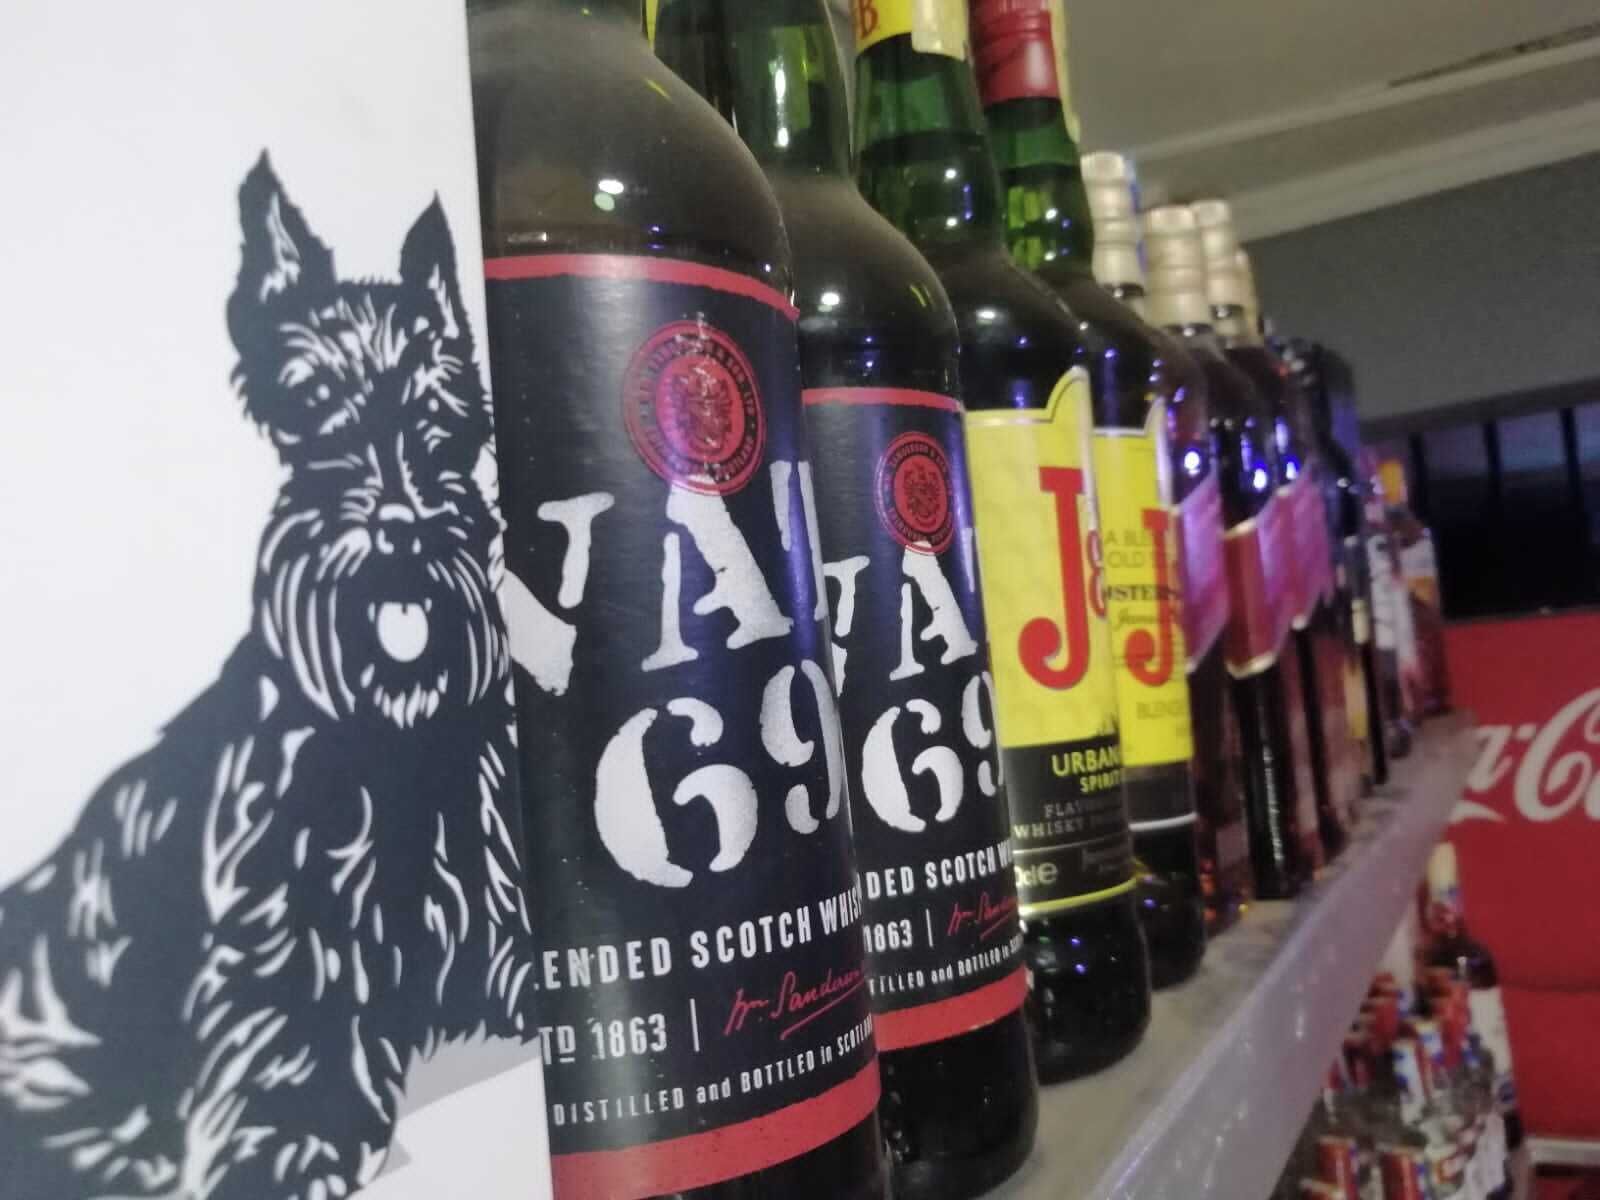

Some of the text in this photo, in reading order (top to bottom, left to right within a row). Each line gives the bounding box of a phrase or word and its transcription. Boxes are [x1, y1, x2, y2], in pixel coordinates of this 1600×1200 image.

[594, 659, 842, 888] 69
[861, 671, 1004, 833] 69
[1052, 745, 1120, 777] URBAN
[1013, 817, 1085, 839] WHISKY
[857, 866, 914, 900] DED
[924, 846, 996, 889] SCOTCH
[533, 938, 672, 990] ENDED
[690, 906, 812, 969] SCOTCH
[863, 919, 913, 953] 1863
[931, 964, 953, 984] and
[957, 946, 1001, 977] BOTTLED
[588, 1013, 668, 1060] 1863
[553, 1086, 684, 1126] DISTILLED
[696, 1077, 731, 1104] and
[740, 1050, 815, 1094] BOTTLED
[820, 1045, 833, 1065] in
